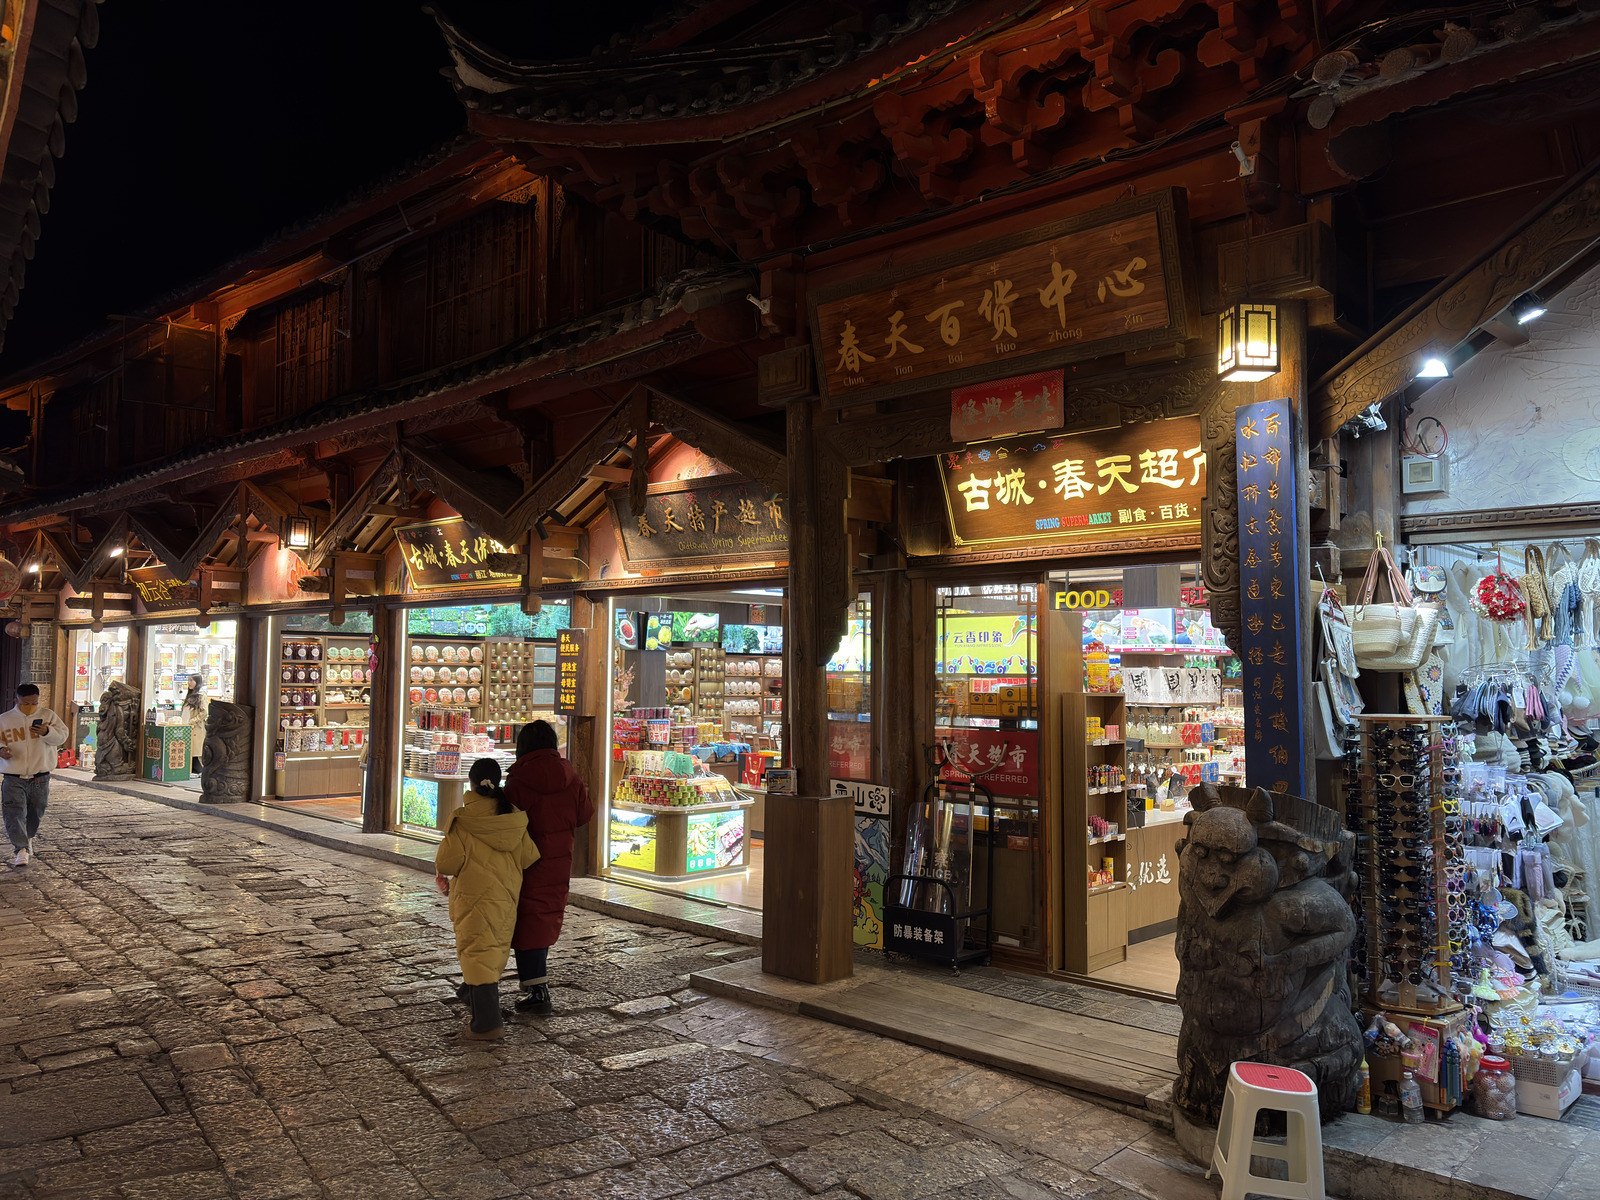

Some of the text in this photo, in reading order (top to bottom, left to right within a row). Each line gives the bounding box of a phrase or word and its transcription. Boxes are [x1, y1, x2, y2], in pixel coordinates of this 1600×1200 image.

[835, 256, 1148, 374] 春天百货中心
[843, 312, 1143, 387] Chun Tian Bai Huo Zhong Xin
[637, 498, 784, 539] 春天特产超市
[1035, 512, 1112, 530] SPRING SUPERMARKET
[711, 537, 734, 550] Spring
[737, 531, 789, 549] Supermarket
[1055, 590, 1110, 610] FOOD
[560, 634, 571, 643] 春天
[560, 678, 577, 688] 母婴室
[560, 693, 576, 704] 休息室
[949, 741, 1027, 769] 春天超市
[944, 769, 1029, 784] SPRIN PREFERRED
[893, 923, 944, 945] 防暴装备架
